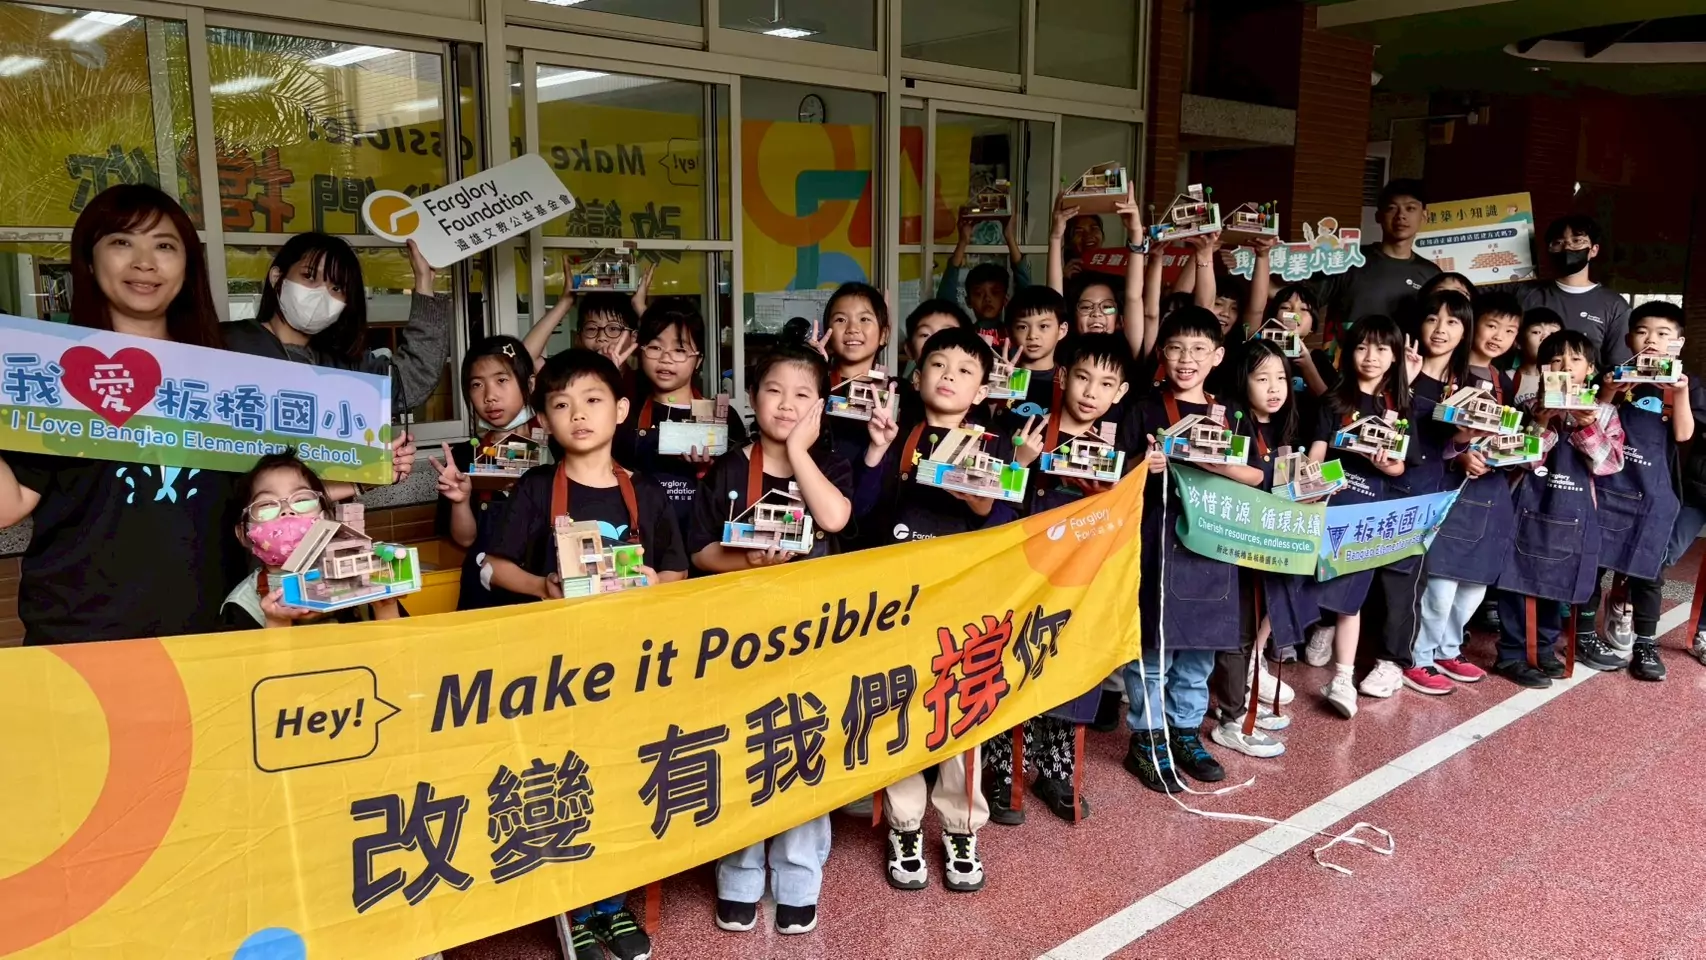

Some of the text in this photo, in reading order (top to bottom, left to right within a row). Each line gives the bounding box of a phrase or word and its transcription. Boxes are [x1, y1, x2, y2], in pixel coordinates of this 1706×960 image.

[423, 180, 498, 217] Farglory
[438, 189, 534, 237] Foundation
[1427, 204, 1498, 224] 建築小知識
[454, 194, 572, 253] 遠雄文教公益基金會
[1, 353, 367, 439] 我愛板橋國小
[27, 410, 82, 438] Love
[89, 420, 177, 447] Banqiao
[183, 430, 293, 456] Elementar
[299, 443, 362, 466] School.
[1188, 486, 1321, 537] 珍惜資源 循環永續
[1198, 517, 1312, 552] Cherish resources, endless cycle.
[1353, 504, 1436, 542] 板橋國小
[431, 585, 920, 732] Make it Possible!
[275, 698, 364, 740] Hey!
[350, 604, 1073, 913] 改變 有我們撐你
